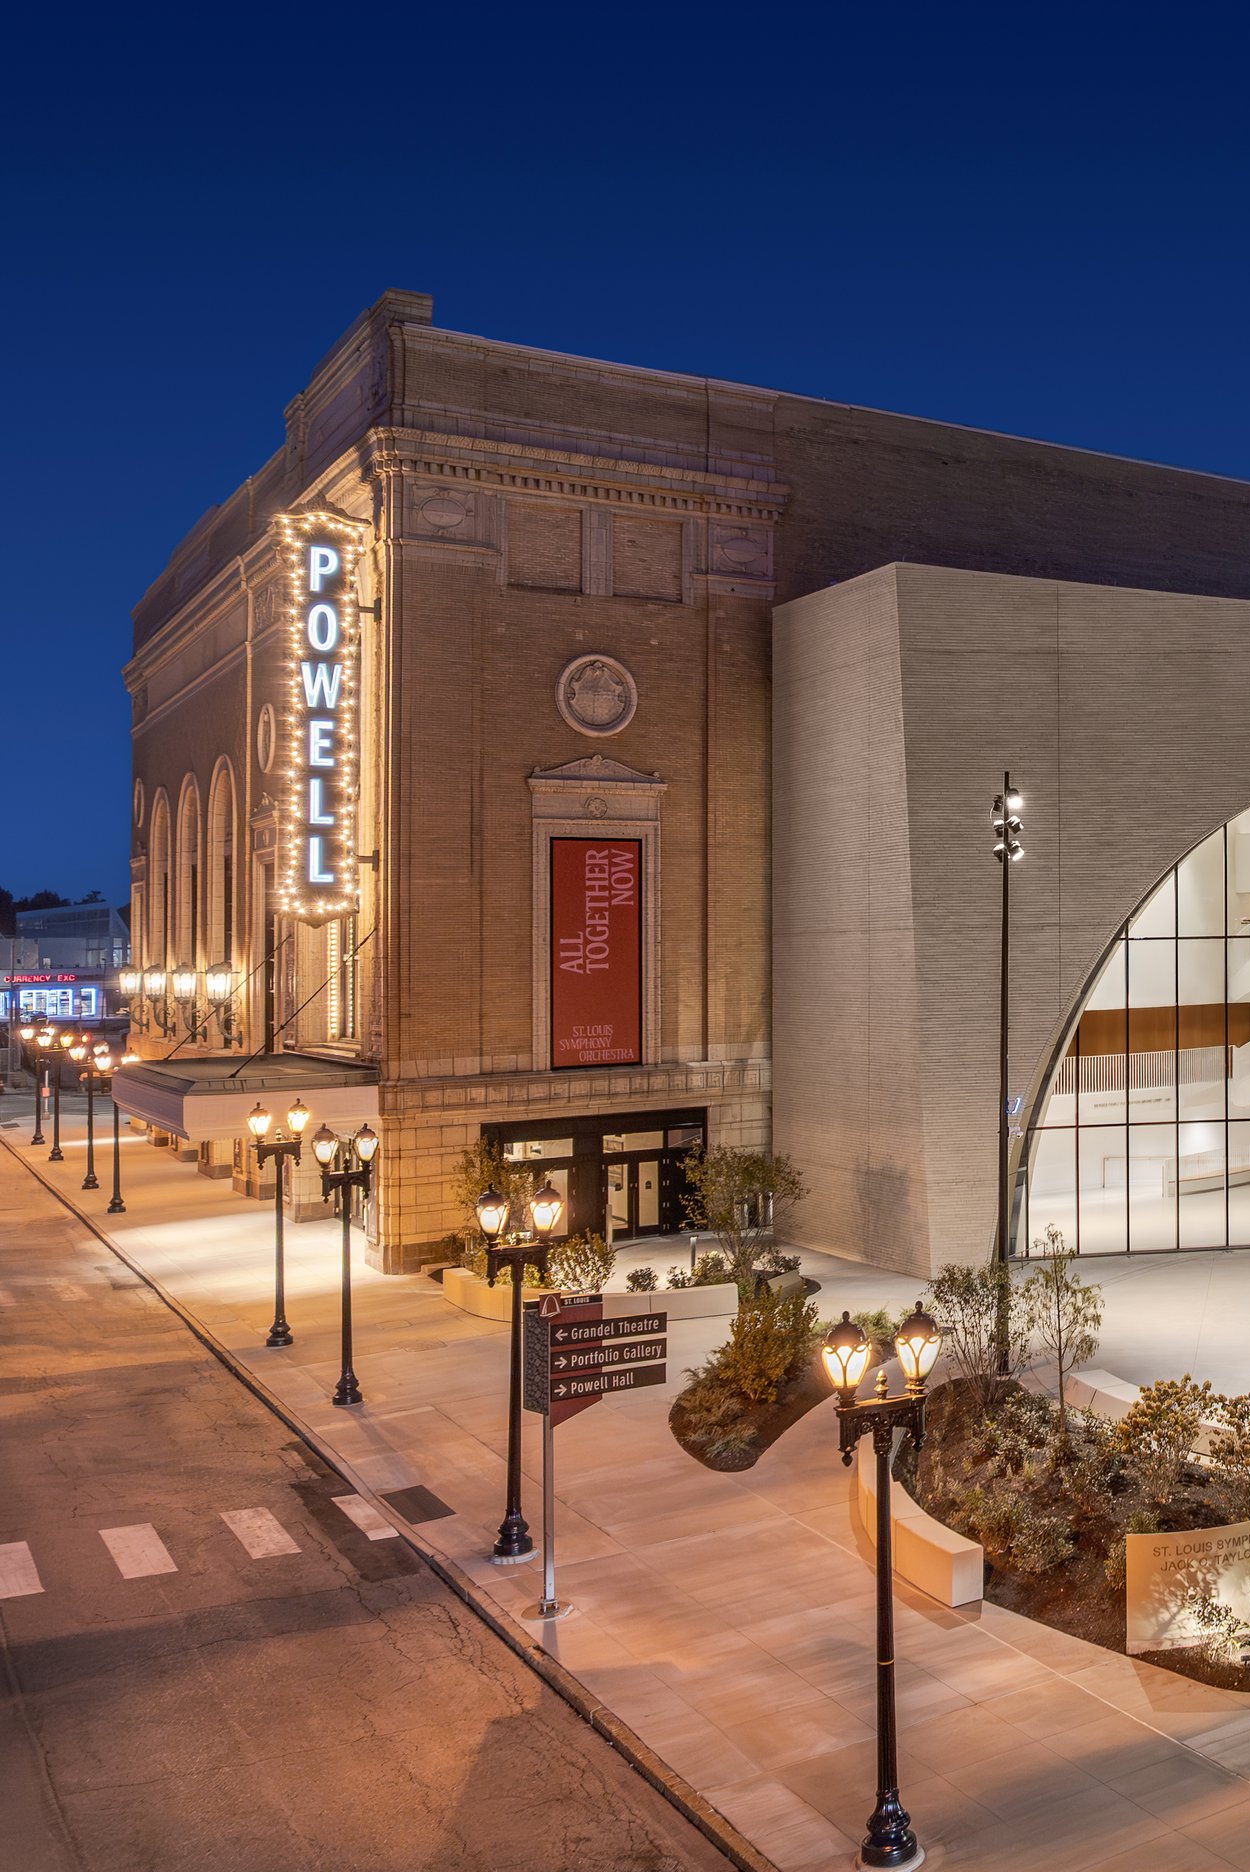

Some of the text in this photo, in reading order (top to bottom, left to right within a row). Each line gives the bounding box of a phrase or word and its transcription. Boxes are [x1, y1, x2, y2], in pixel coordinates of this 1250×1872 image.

[301, 545, 343, 883] POWELL
[611, 848, 634, 905] NOW
[585, 849, 609, 974] TOGETHER
[560, 931, 584, 974] ALL
[587, 1025, 613, 1036] LOUIS
[559, 1037, 612, 1051] SYMPHONY
[579, 1048, 634, 1062] ORCHESTRA
[573, 1296, 590, 1304] LOUIS
[571, 1318, 659, 1340] Grandel Theatre
[571, 1344, 662, 1367] Portfolio Gallery
[571, 1372, 634, 1394] Powell Hall
[1153, 1546, 1171, 1557] ST.
[1176, 1541, 1212, 1556] LOUIS
[1161, 1559, 1194, 1572] JACK
